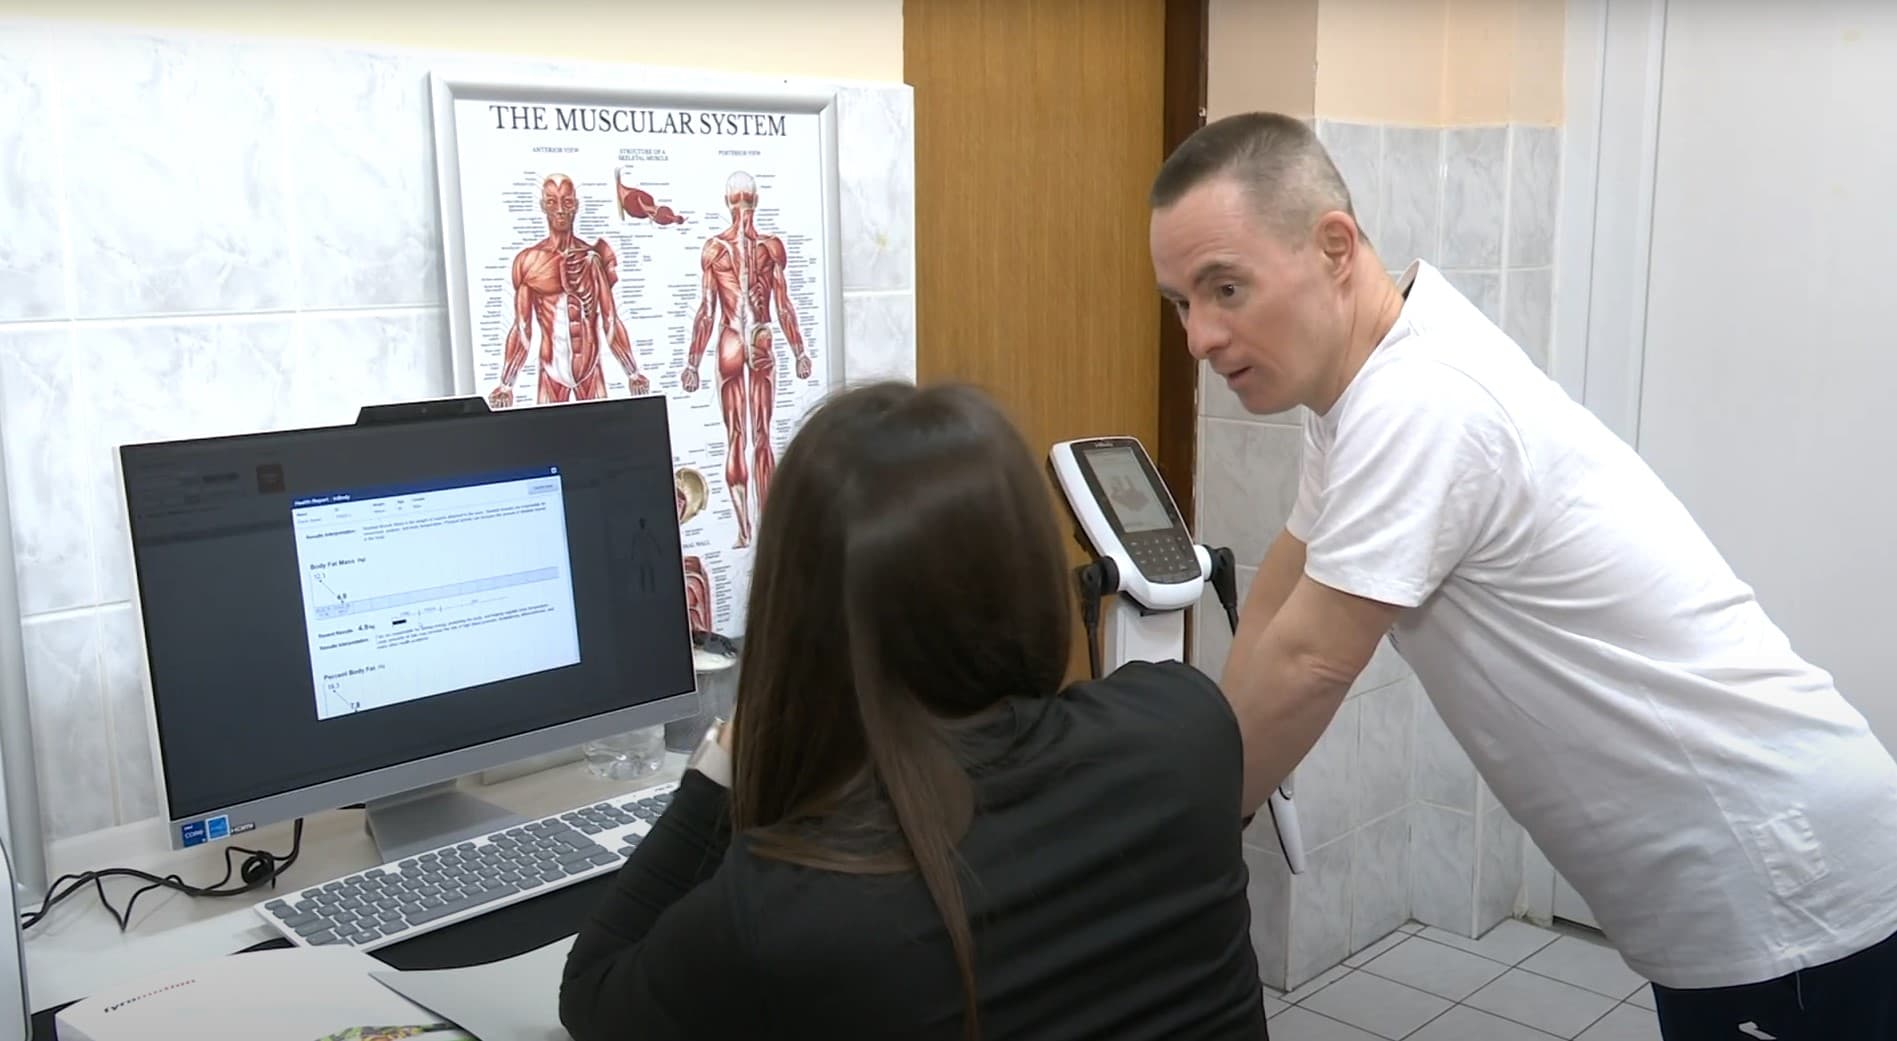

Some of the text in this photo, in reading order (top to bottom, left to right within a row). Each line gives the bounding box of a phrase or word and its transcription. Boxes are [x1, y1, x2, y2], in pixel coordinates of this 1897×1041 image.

[489, 105, 786, 136] THE MUSCULAR SYSTEM
[310, 563, 326, 571] Body
[323, 671, 347, 680] Percent
[349, 668, 364, 676] Body
